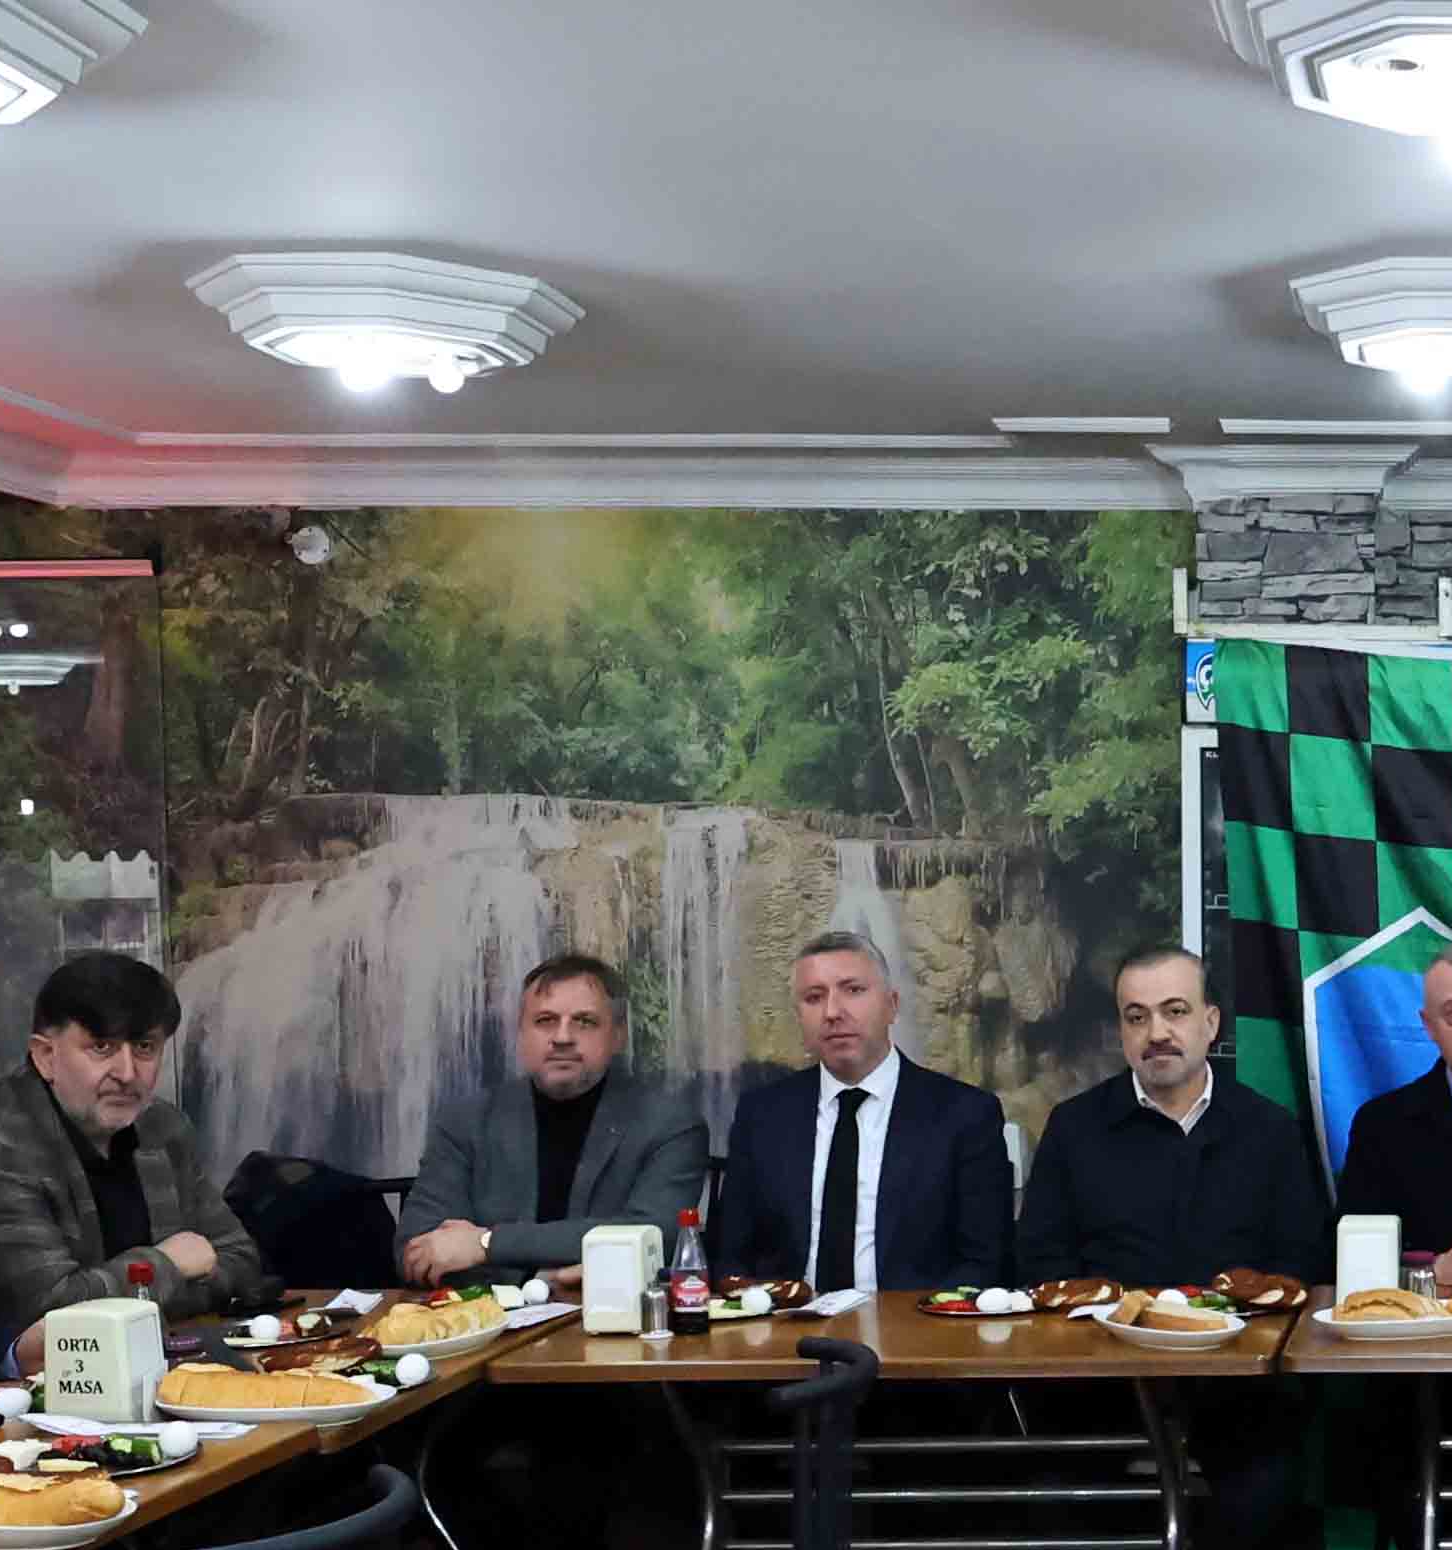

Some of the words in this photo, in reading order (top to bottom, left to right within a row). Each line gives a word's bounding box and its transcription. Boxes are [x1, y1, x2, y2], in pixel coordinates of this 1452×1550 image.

[58, 1338, 100, 1352] ORTA
[75, 1360, 84, 1373] 3
[59, 1380, 104, 1394] MASA
